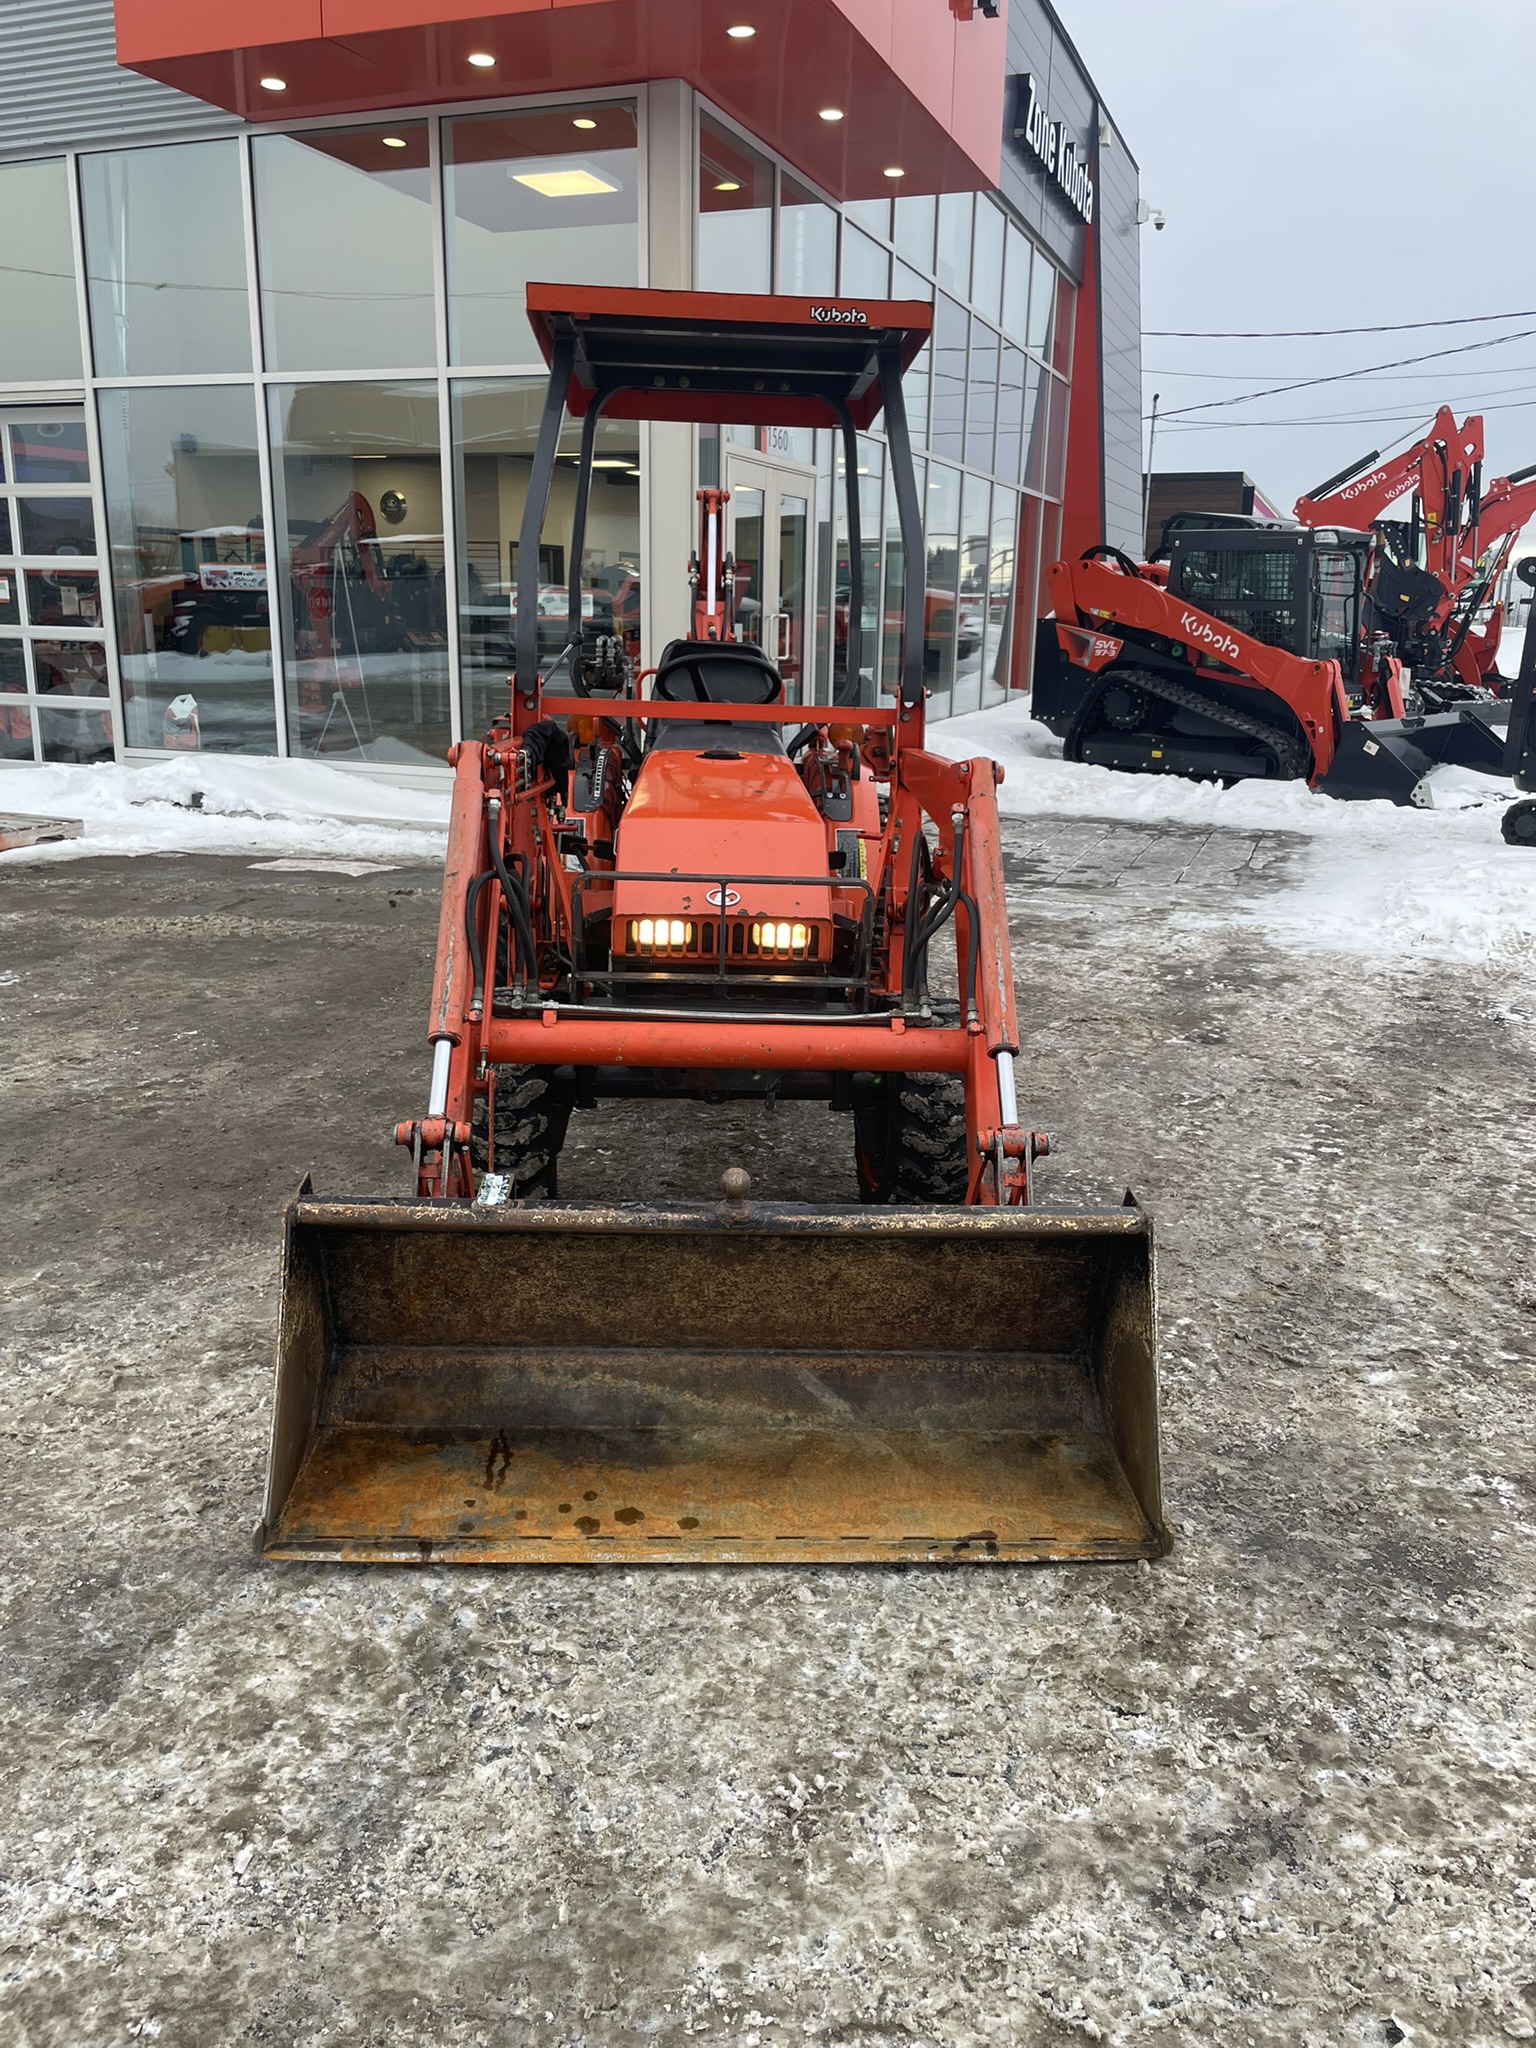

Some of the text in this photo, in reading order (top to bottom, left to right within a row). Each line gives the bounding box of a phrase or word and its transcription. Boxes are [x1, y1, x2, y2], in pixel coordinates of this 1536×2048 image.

[1025, 74, 1094, 225] Zone Kubota
[810, 306, 867, 323] Kubota
[767, 426, 789, 451] 1560
[1340, 471, 1387, 500] Kubota
[1384, 473, 1421, 500] Kubota
[1094, 640, 1118, 650] SVL
[1180, 611, 1240, 659] Kubota
[1094, 649, 1116, 657] 97-3
